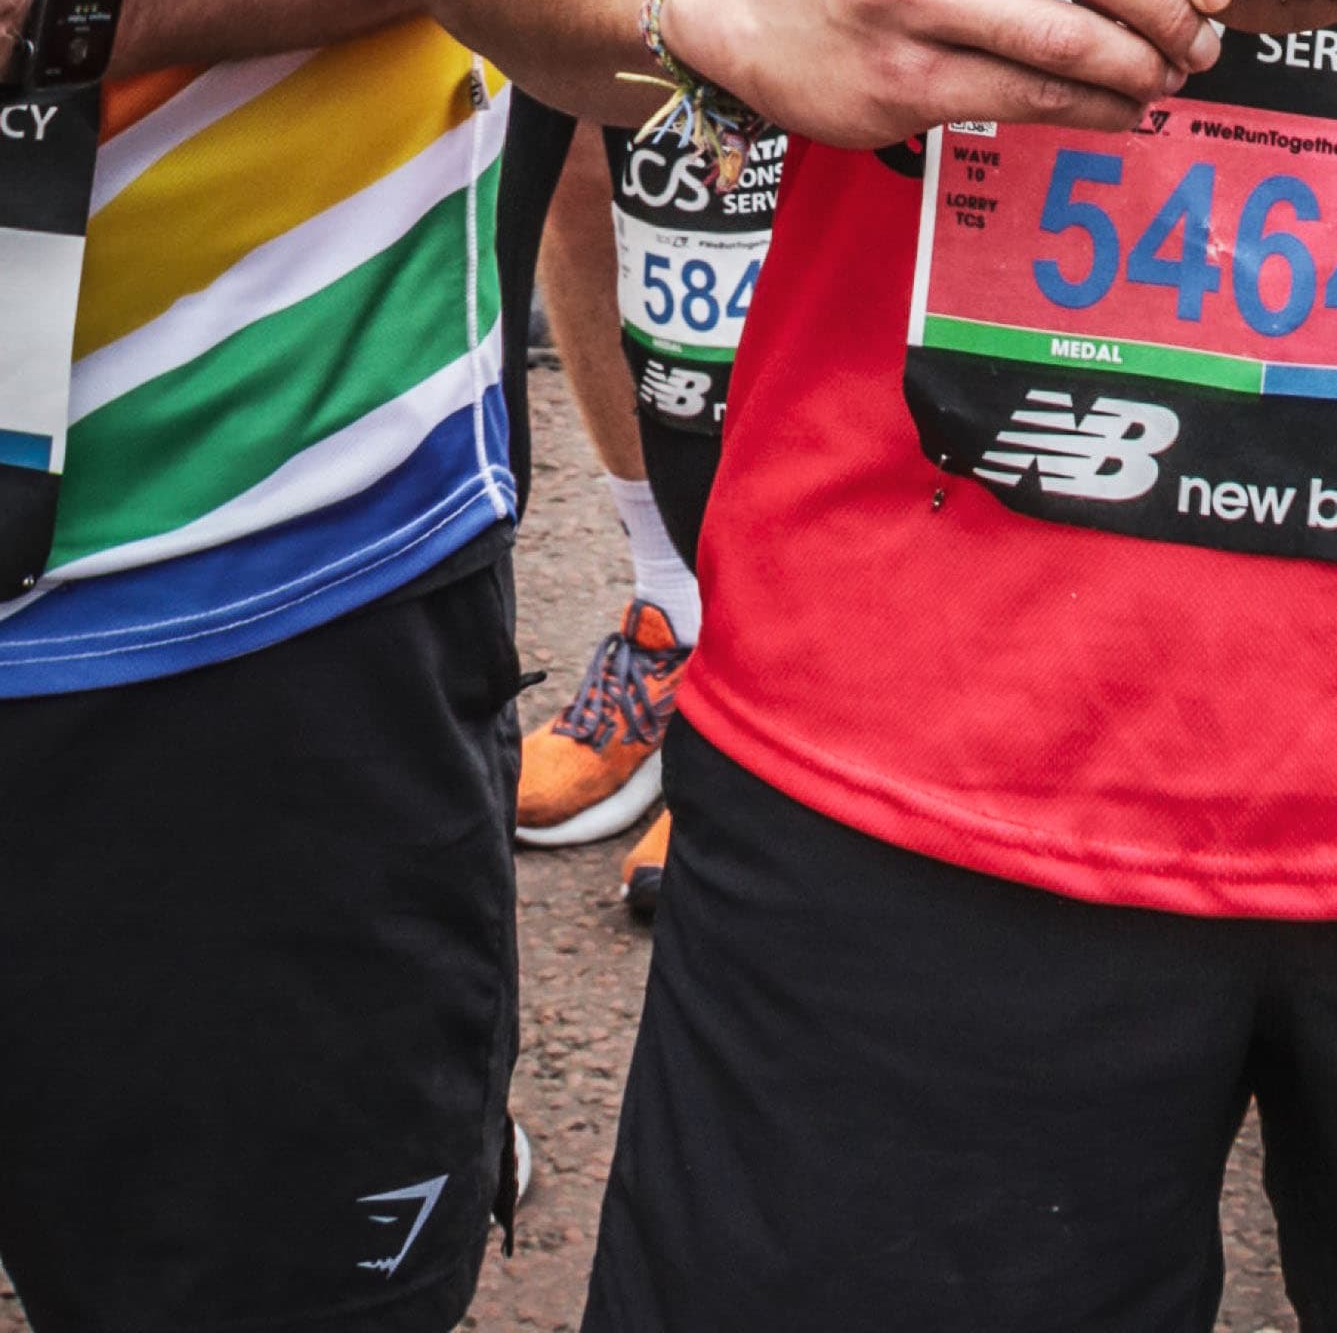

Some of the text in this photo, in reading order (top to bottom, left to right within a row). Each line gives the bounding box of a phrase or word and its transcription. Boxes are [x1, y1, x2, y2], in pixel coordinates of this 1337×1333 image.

[953, 146, 1000, 167] WAVE
[967, 165, 986, 183] 10
[946, 193, 998, 213] LORRY
[956, 211, 986, 230] TCS
[1050, 338, 1123, 365] MEDAL
[1178, 474, 1297, 527] new
